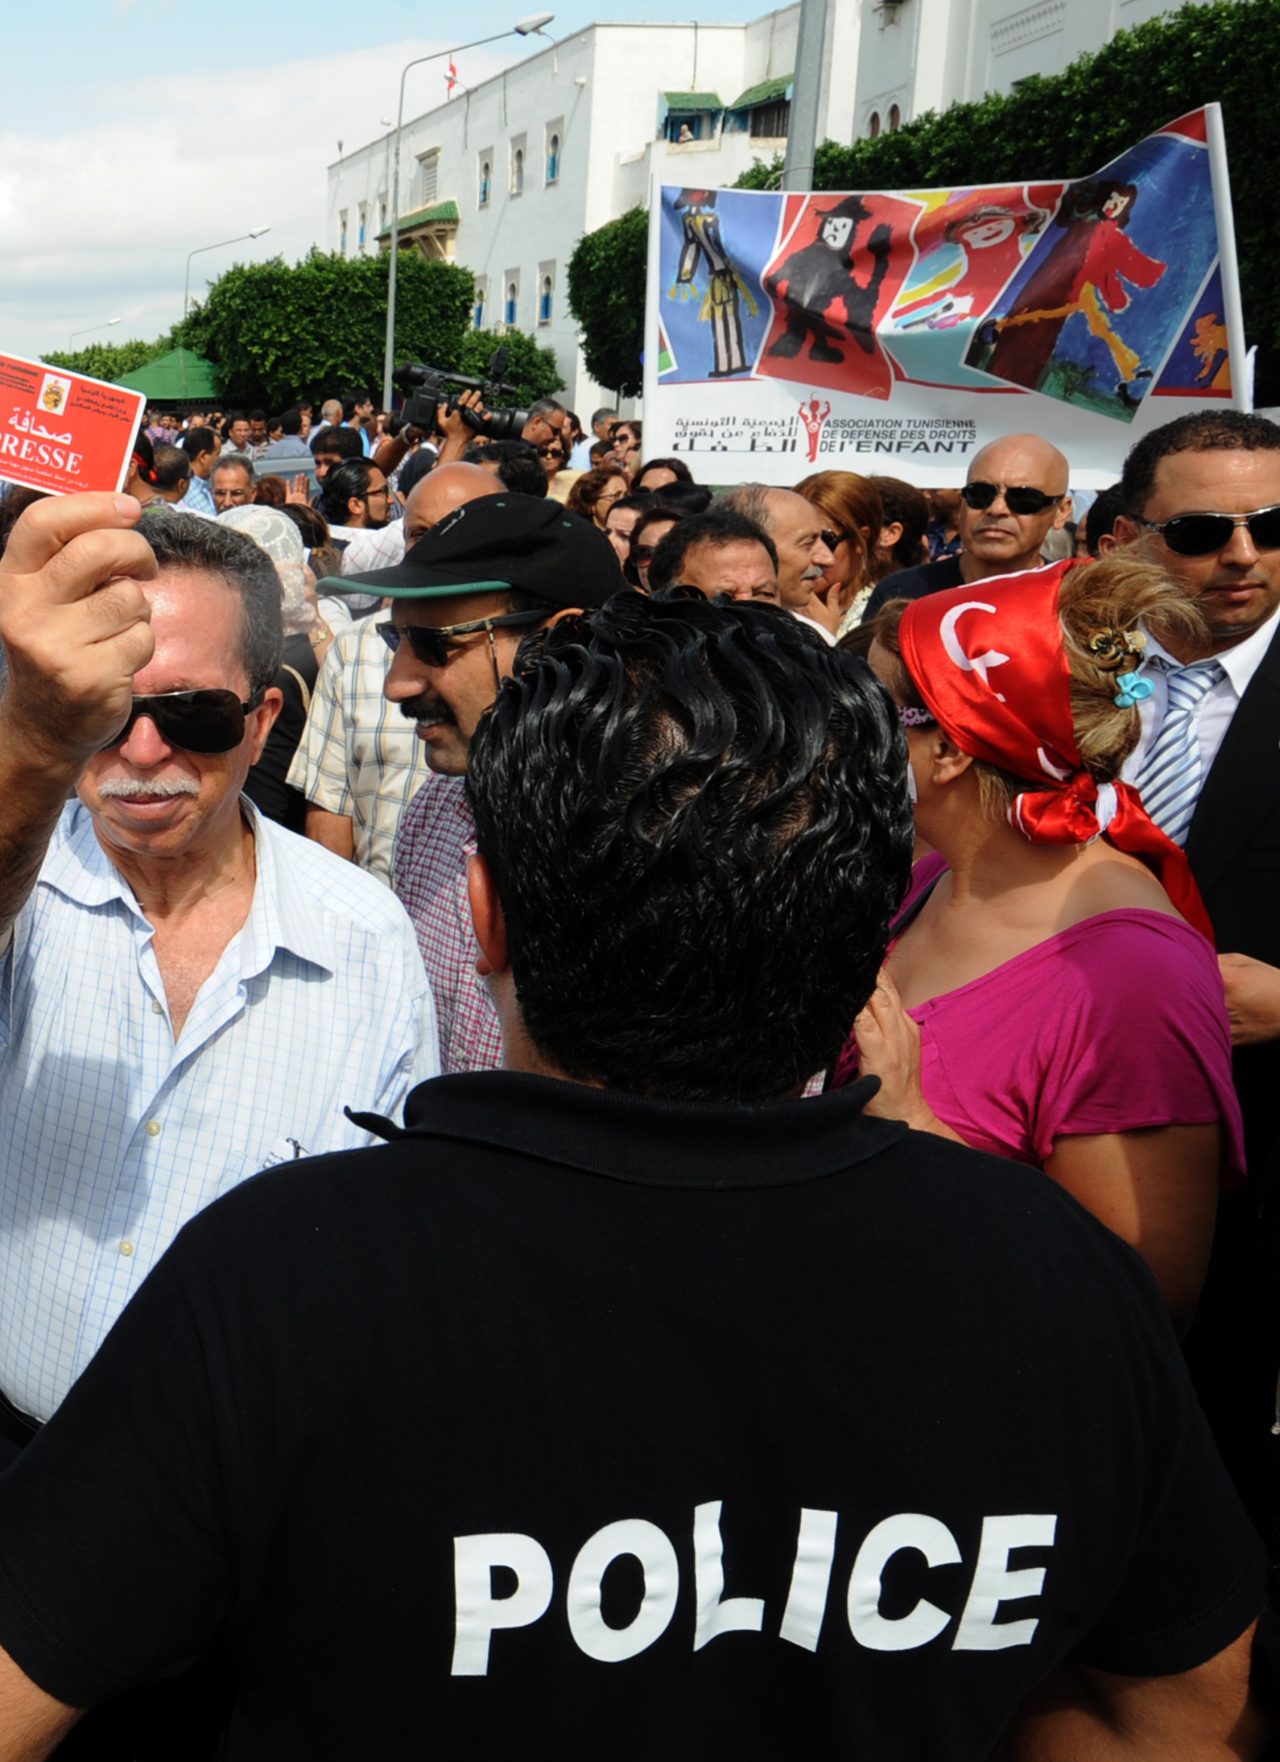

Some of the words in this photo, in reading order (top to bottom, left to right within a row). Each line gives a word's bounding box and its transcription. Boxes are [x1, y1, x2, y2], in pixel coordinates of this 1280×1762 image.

[8, 407, 72, 445] صحافة
[676, 416, 736, 429] التونسية
[742, 416, 800, 429] الجمعية
[824, 419, 903, 429] ASSOCIATION
[906, 419, 976, 429] TUNISIENNE
[675, 427, 714, 438] حقوق
[721, 428, 744, 438] عن
[750, 426, 798, 439] للدفاع
[821, 429, 837, 440] DE
[841, 429, 896, 440] DEFENSE
[900, 429, 926, 440] DES
[929, 429, 977, 440] DROITS
[819, 440, 836, 453] DE
[451, 1500, 1058, 1676] POLICE
